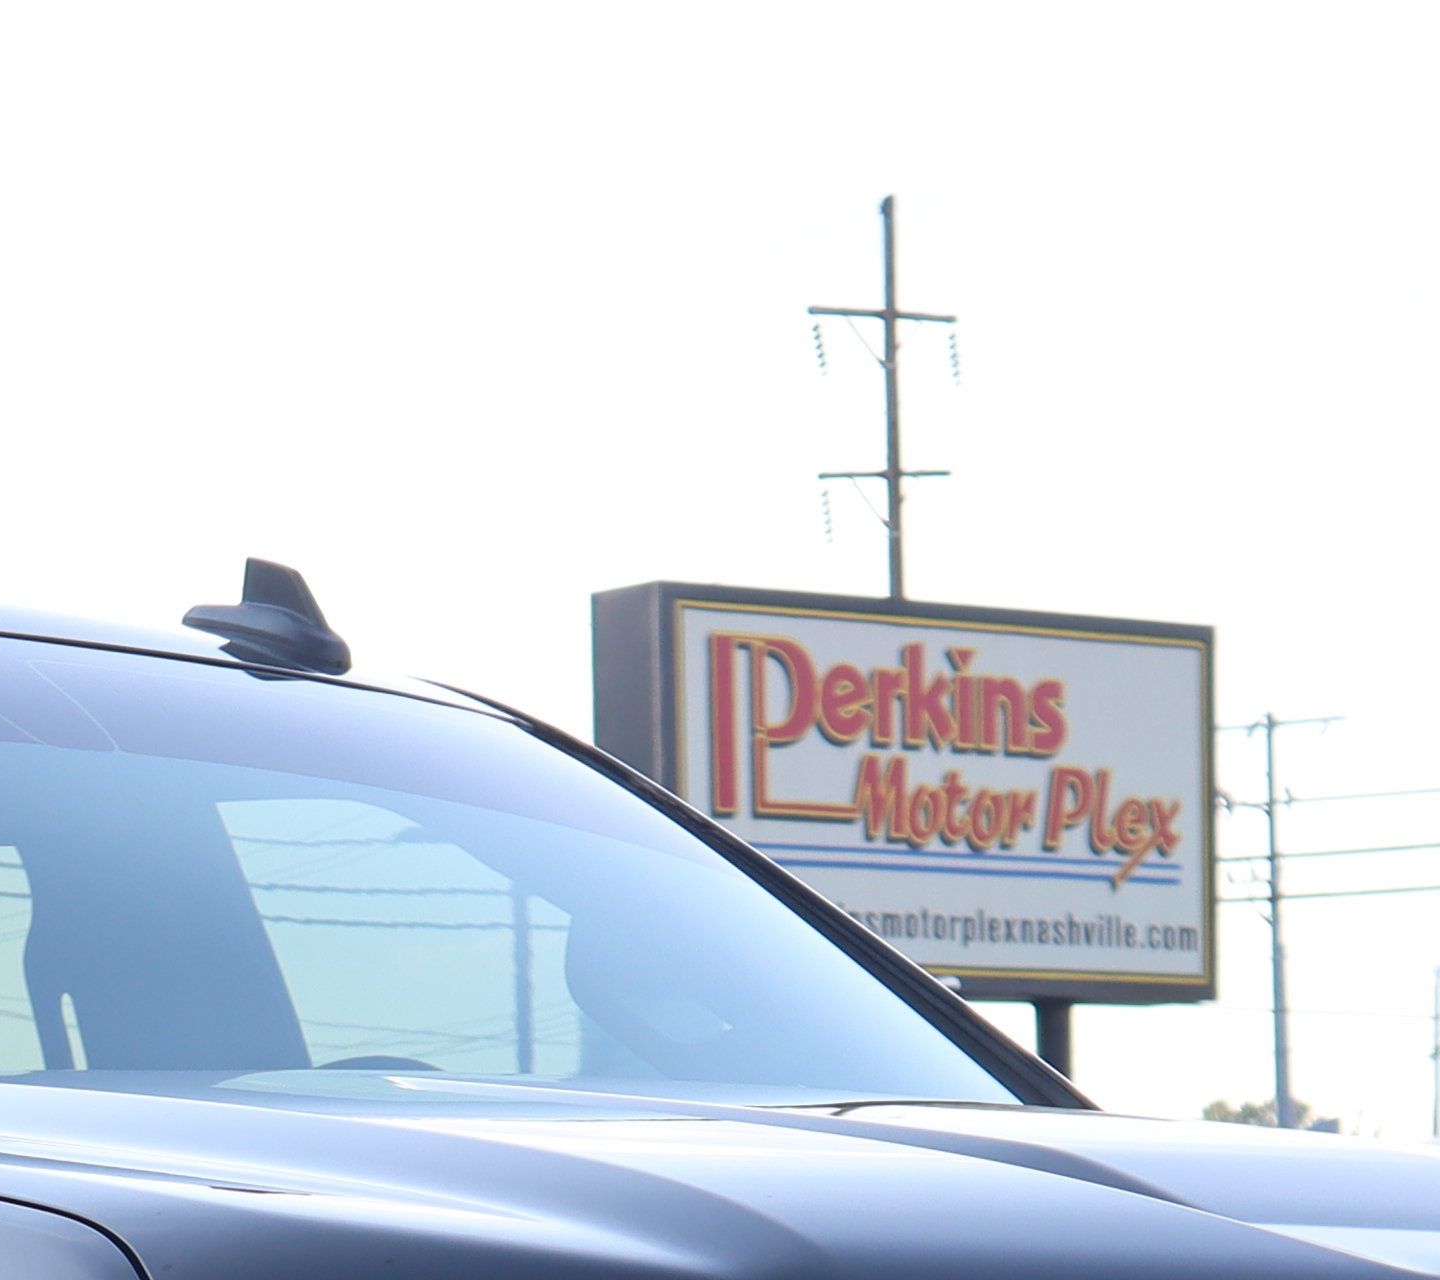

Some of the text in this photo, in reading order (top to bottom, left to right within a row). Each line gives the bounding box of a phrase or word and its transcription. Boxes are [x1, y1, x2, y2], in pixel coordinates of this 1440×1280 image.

[709, 632, 1068, 817] Perkins
[855, 754, 1185, 888] Motor Plex
